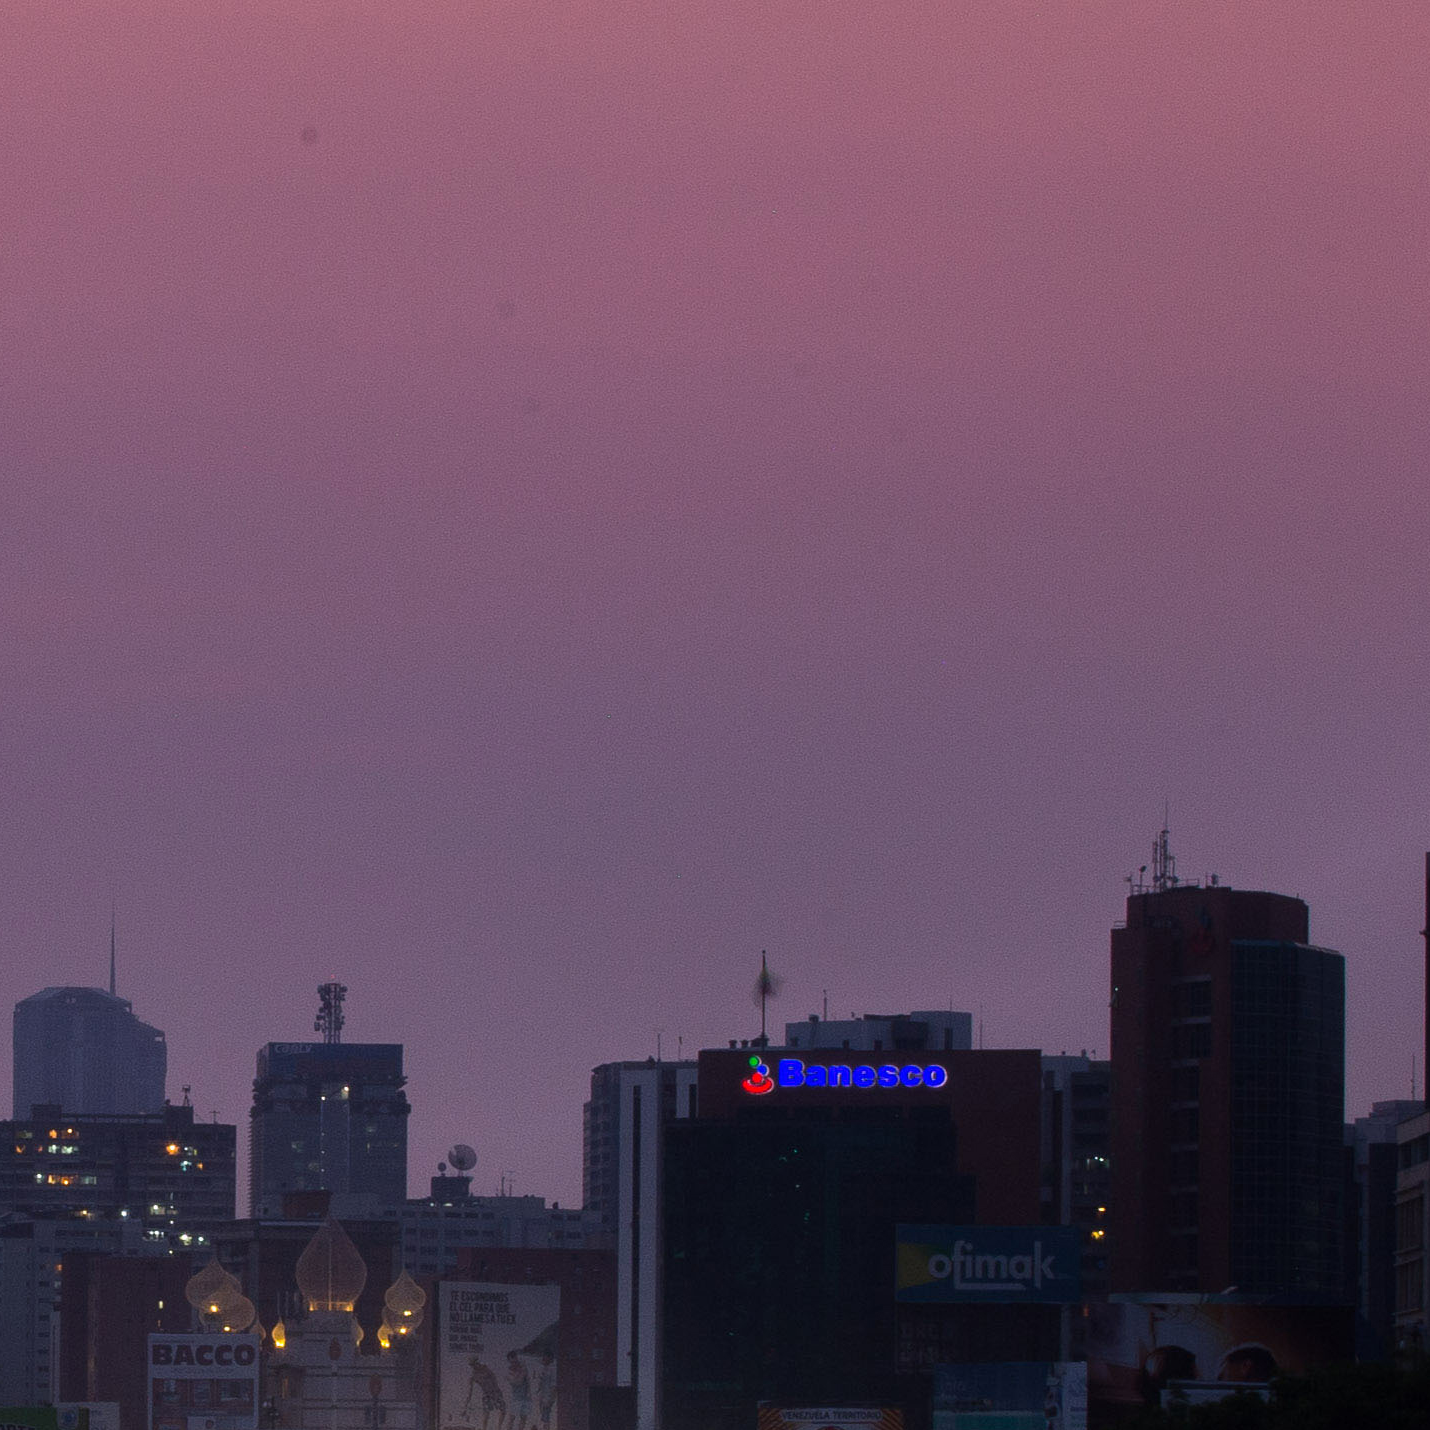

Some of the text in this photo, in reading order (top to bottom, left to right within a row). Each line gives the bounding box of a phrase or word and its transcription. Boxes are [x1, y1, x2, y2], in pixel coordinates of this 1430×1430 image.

[778, 1059, 947, 1087] Banesco
[927, 1240, 1055, 1290] ofimak
[152, 1344, 254, 1366] BACCO
[781, 1411, 881, 1420] VENEZUELA TERRITORIO
